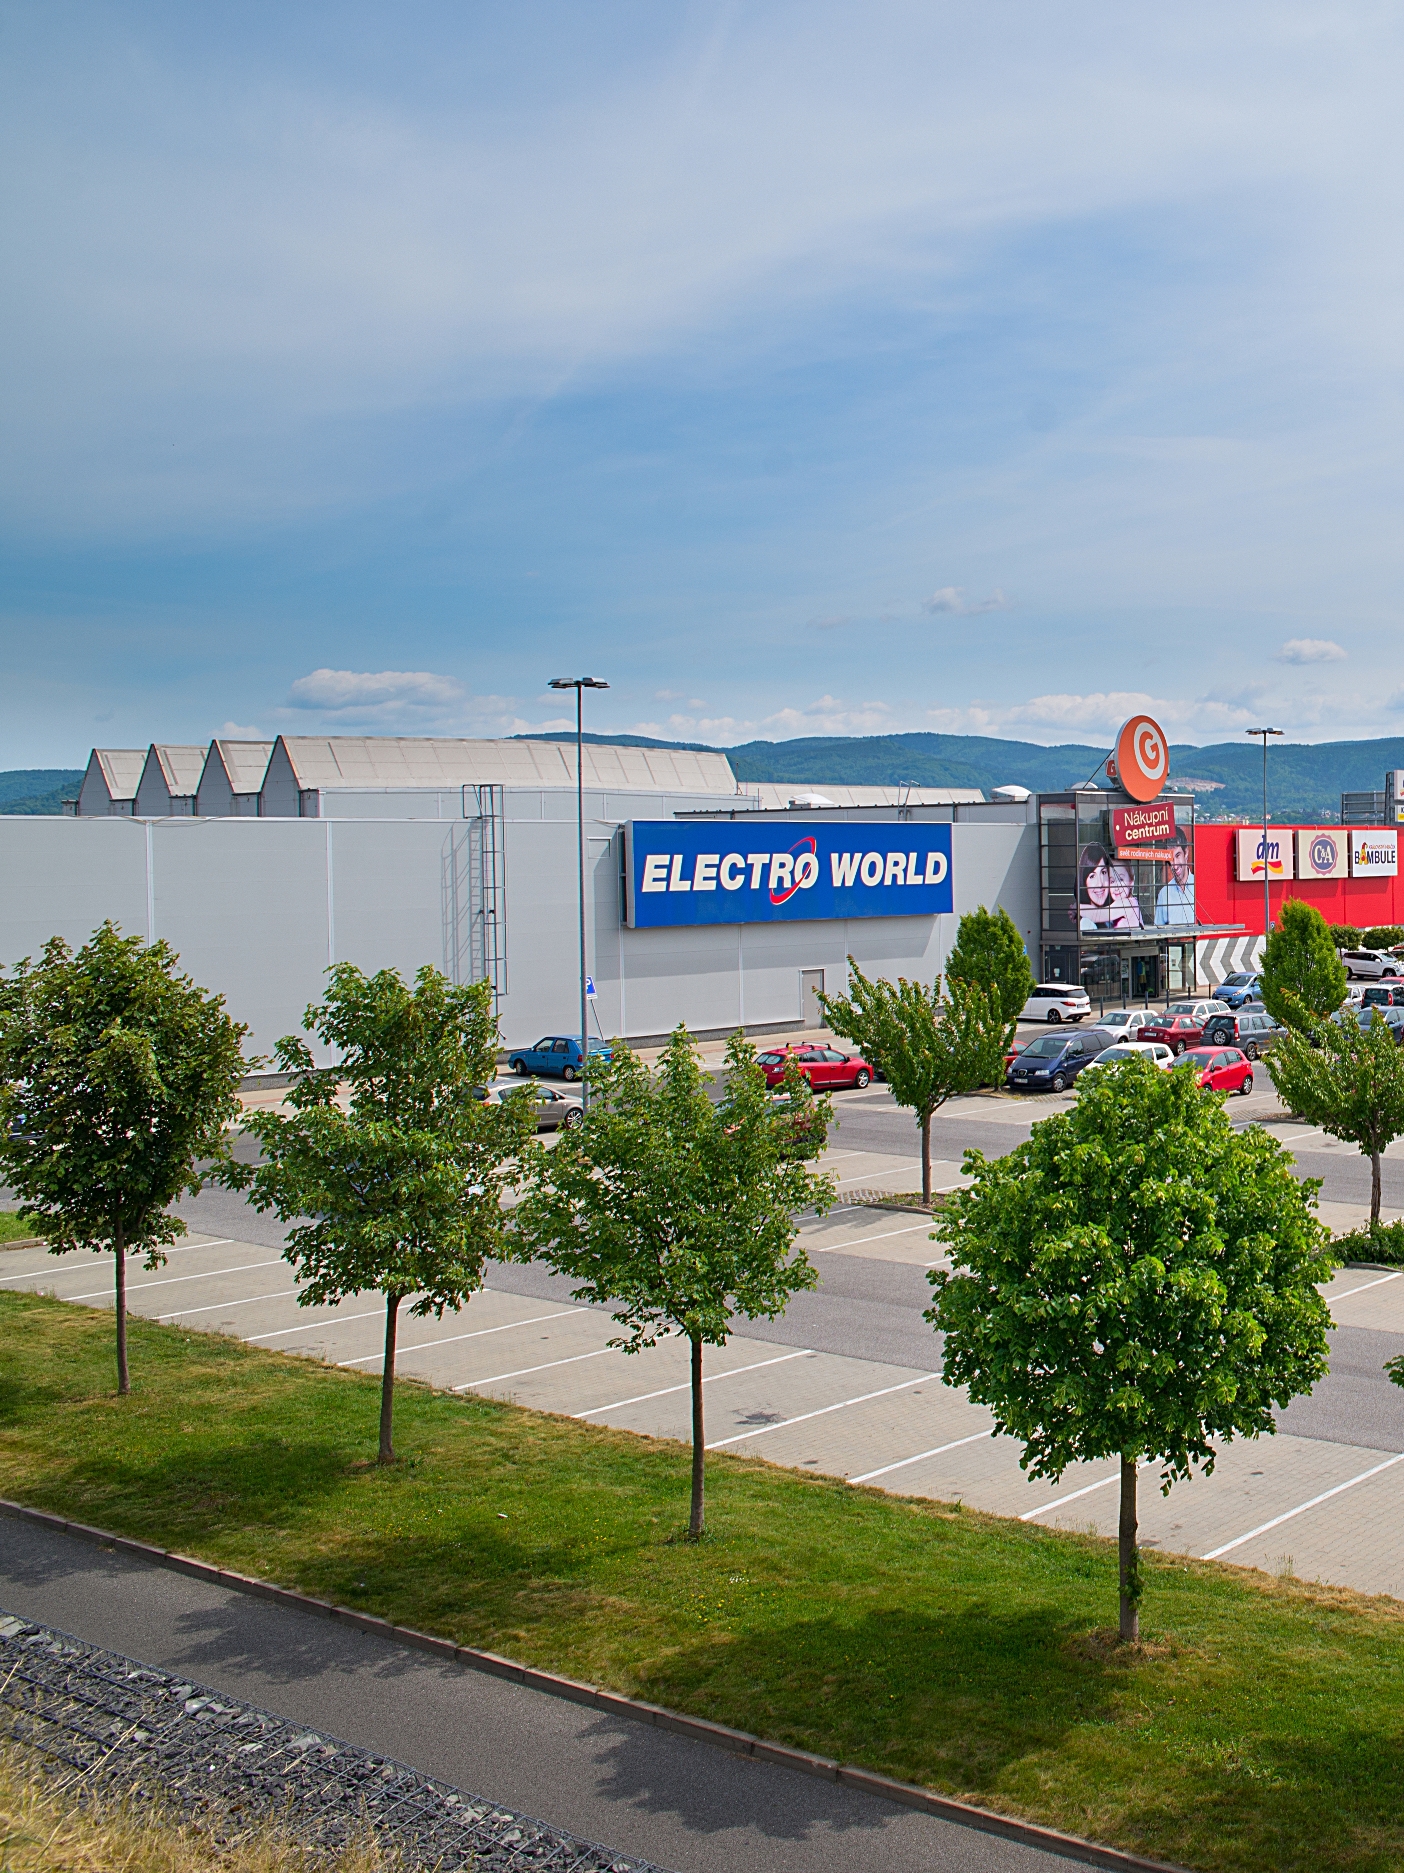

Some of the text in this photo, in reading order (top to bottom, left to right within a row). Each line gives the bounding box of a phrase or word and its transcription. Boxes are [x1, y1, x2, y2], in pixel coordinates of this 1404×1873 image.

[1124, 807, 1168, 827] Nákupní
[1125, 825, 1170, 841] centrum
[1131, 850, 1155, 859] rodinných
[1256, 834, 1280, 860] dm
[1315, 845, 1333, 864] C&A
[1354, 844, 1396, 865] BAMBULE
[641, 851, 948, 893] ELECTRO WORLD
